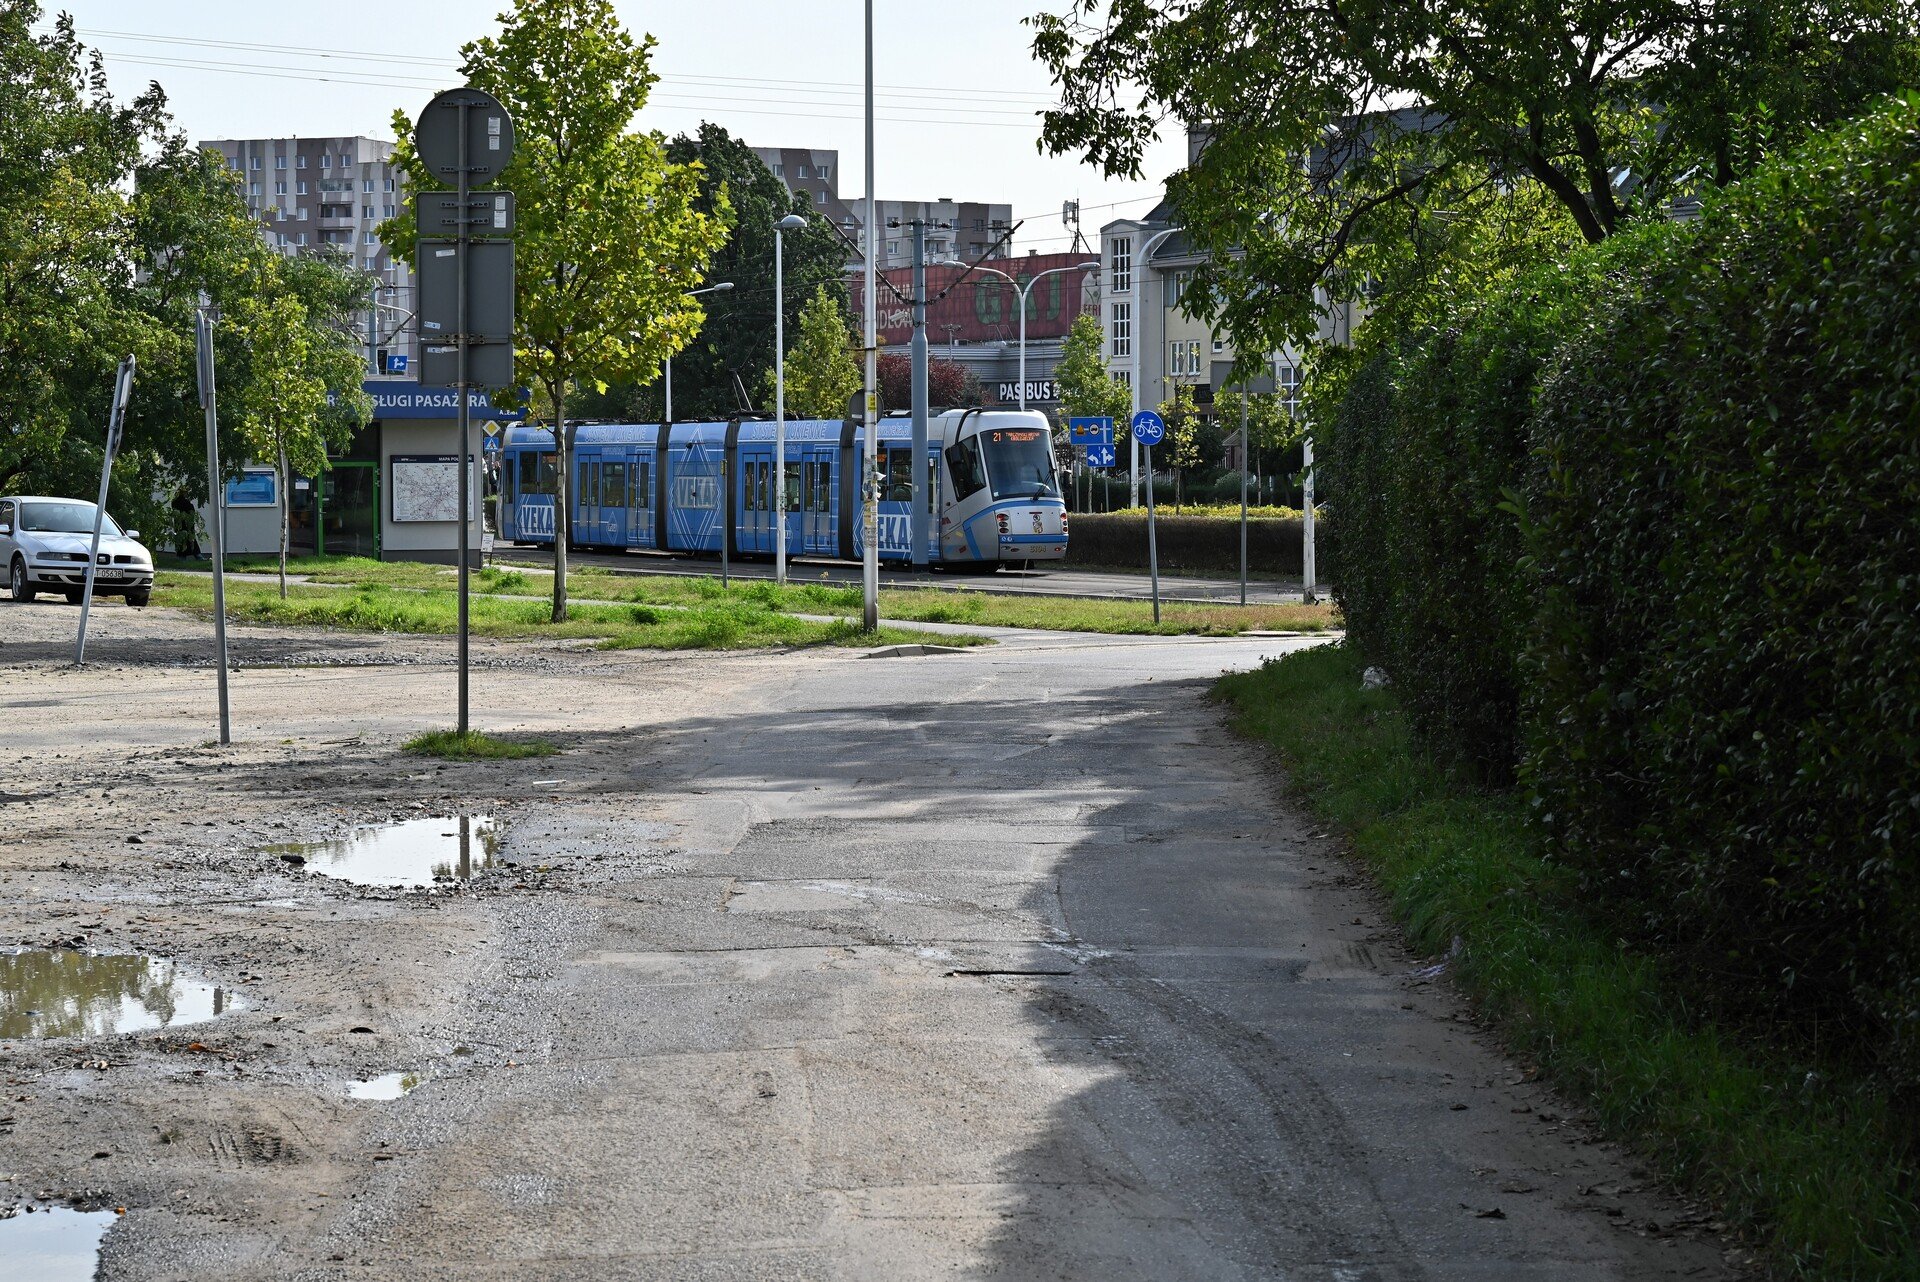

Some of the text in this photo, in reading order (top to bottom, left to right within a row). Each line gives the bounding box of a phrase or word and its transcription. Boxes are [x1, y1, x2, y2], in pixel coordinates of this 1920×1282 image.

[860, 283, 915, 307] CNTRUM
[977, 271, 1061, 323] GAJ
[415, 392, 487, 407] PASAŻRA
[999, 381, 1051, 401] PASBUS
[752, 423, 789, 440] SYSTEY
[992, 432, 1002, 442] 21
[678, 478, 713, 507] VEKA
[522, 507, 554, 534] VEKA
[878, 516, 910, 550] EKA
